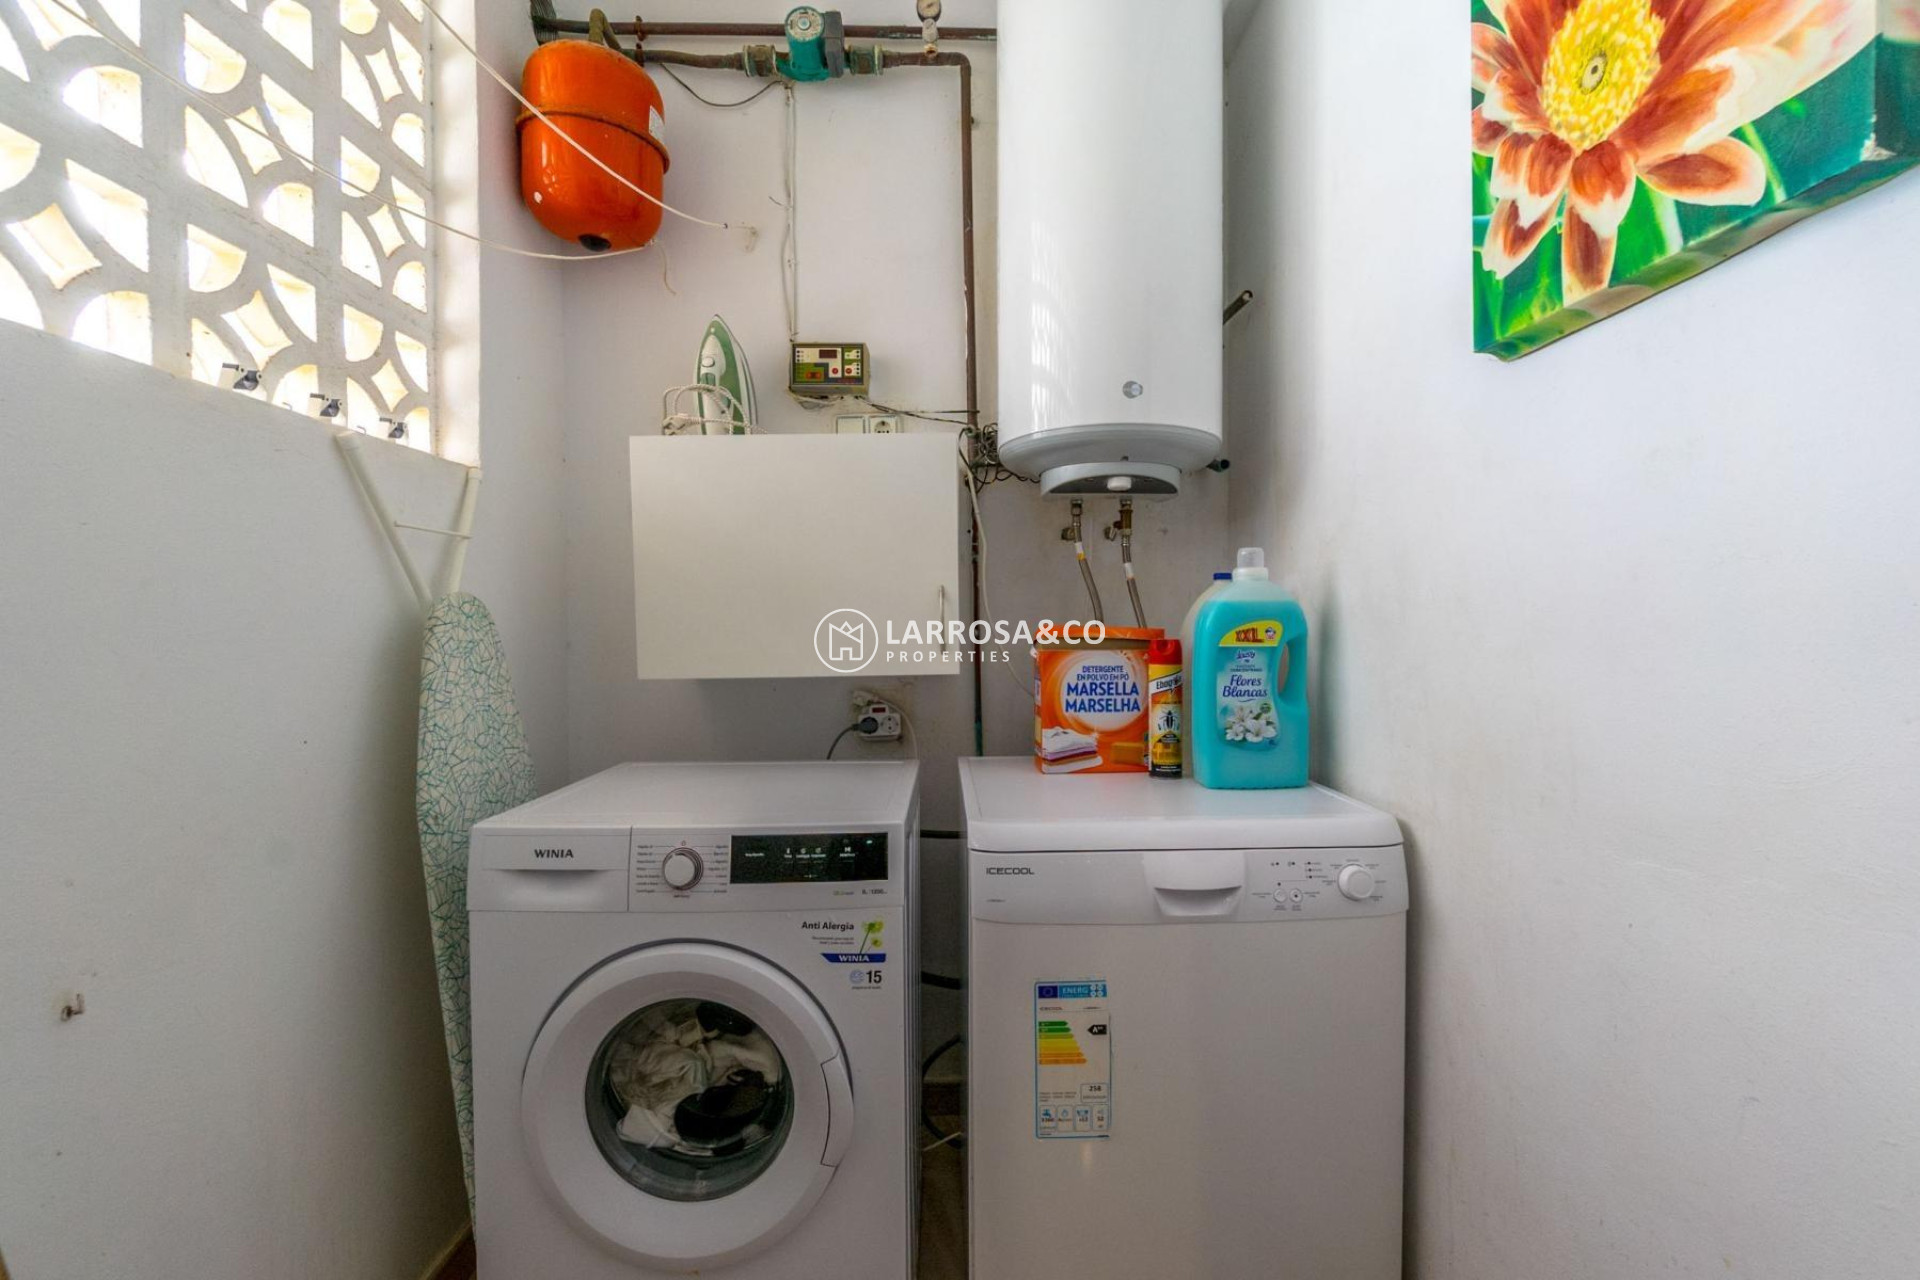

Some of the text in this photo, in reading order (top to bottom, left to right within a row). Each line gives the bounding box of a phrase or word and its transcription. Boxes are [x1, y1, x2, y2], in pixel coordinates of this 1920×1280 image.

[1082, 665, 1124, 673] DETERGENTE
[1230, 674, 1262, 686] Flores
[1066, 682, 1139, 696] MARSELLA
[1222, 685, 1268, 698] Blancas
[1065, 698, 1140, 713] MARSELHA
[534, 848, 574, 859] WINIA
[986, 867, 1035, 875] ICECOOL
[801, 921, 854, 932] Anti Alergia
[838, 954, 869, 962] WINIA
[866, 970, 882, 984] 15
